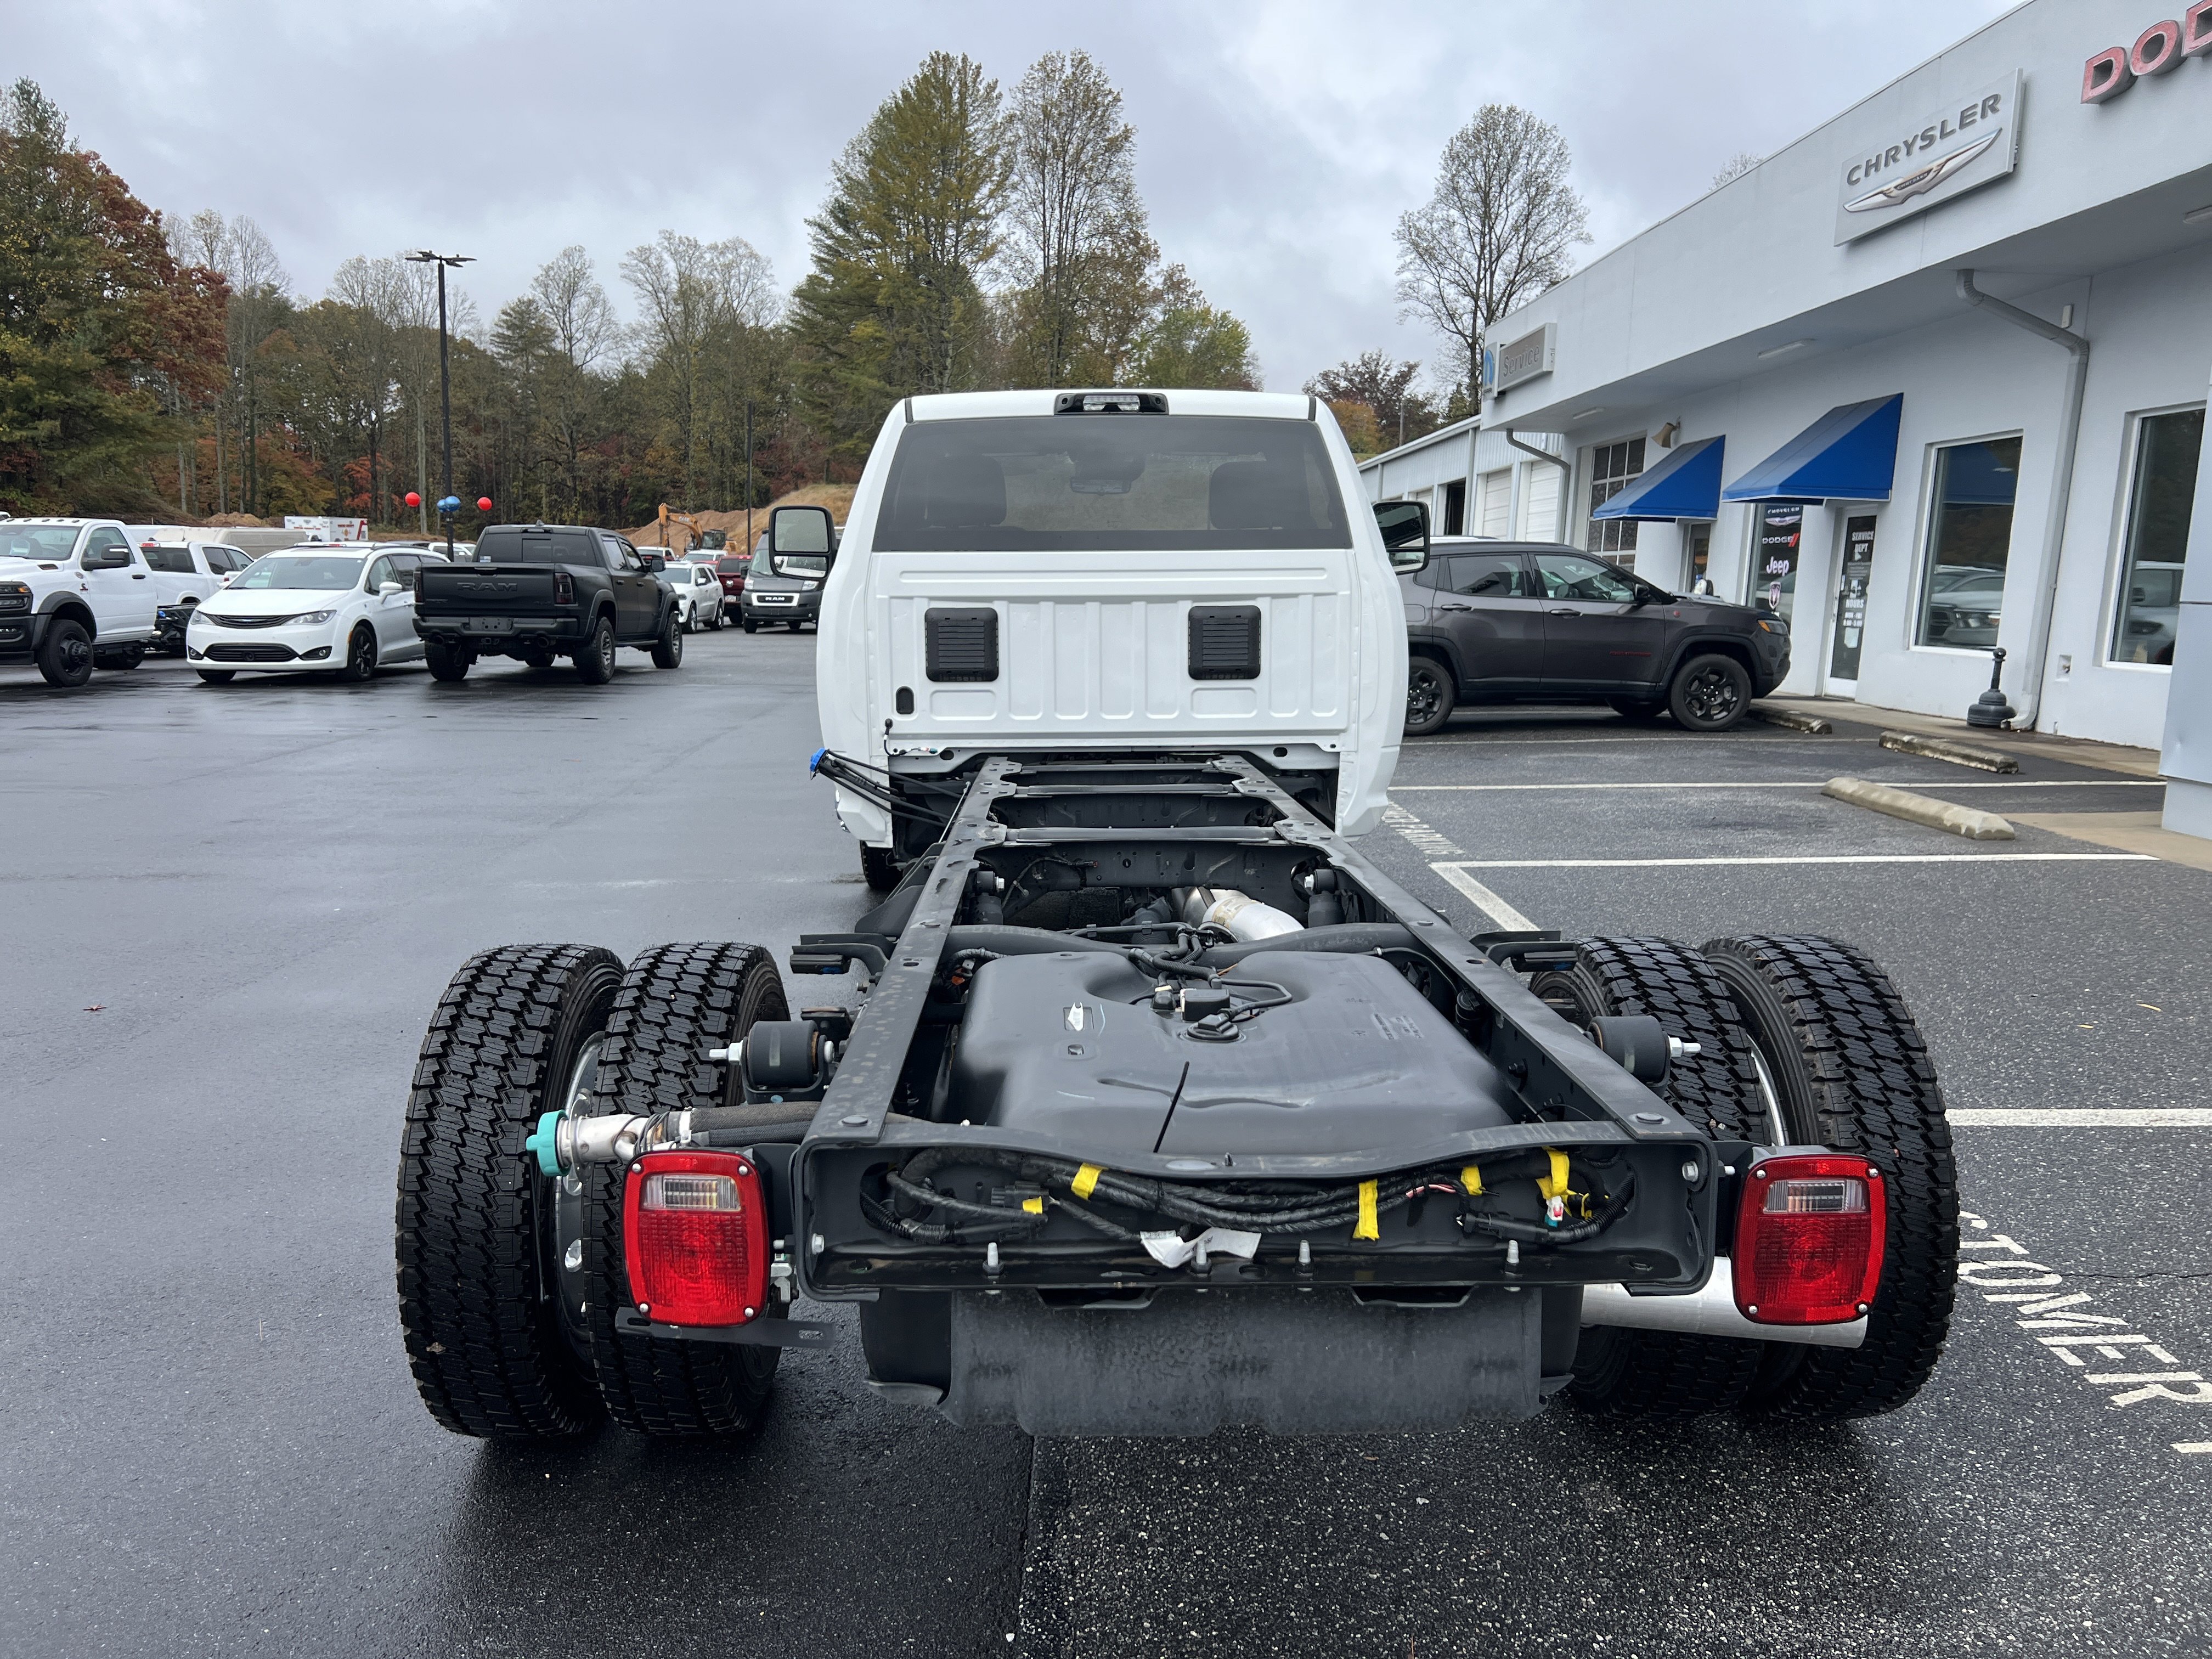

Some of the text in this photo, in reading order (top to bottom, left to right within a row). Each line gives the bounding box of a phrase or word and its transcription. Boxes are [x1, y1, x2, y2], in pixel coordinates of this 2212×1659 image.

[1847, 93, 2001, 185] CHRYSLER
[1503, 345, 1539, 377] Service
[1762, 535, 1793, 544] DODGE
[1852, 531, 1874, 541] SERVICE
[1855, 543, 1868, 552] DEPT
[1767, 556, 1789, 577] Jeep
[457, 583, 517, 591] RAM
[1846, 599, 1864, 608] HOURS
